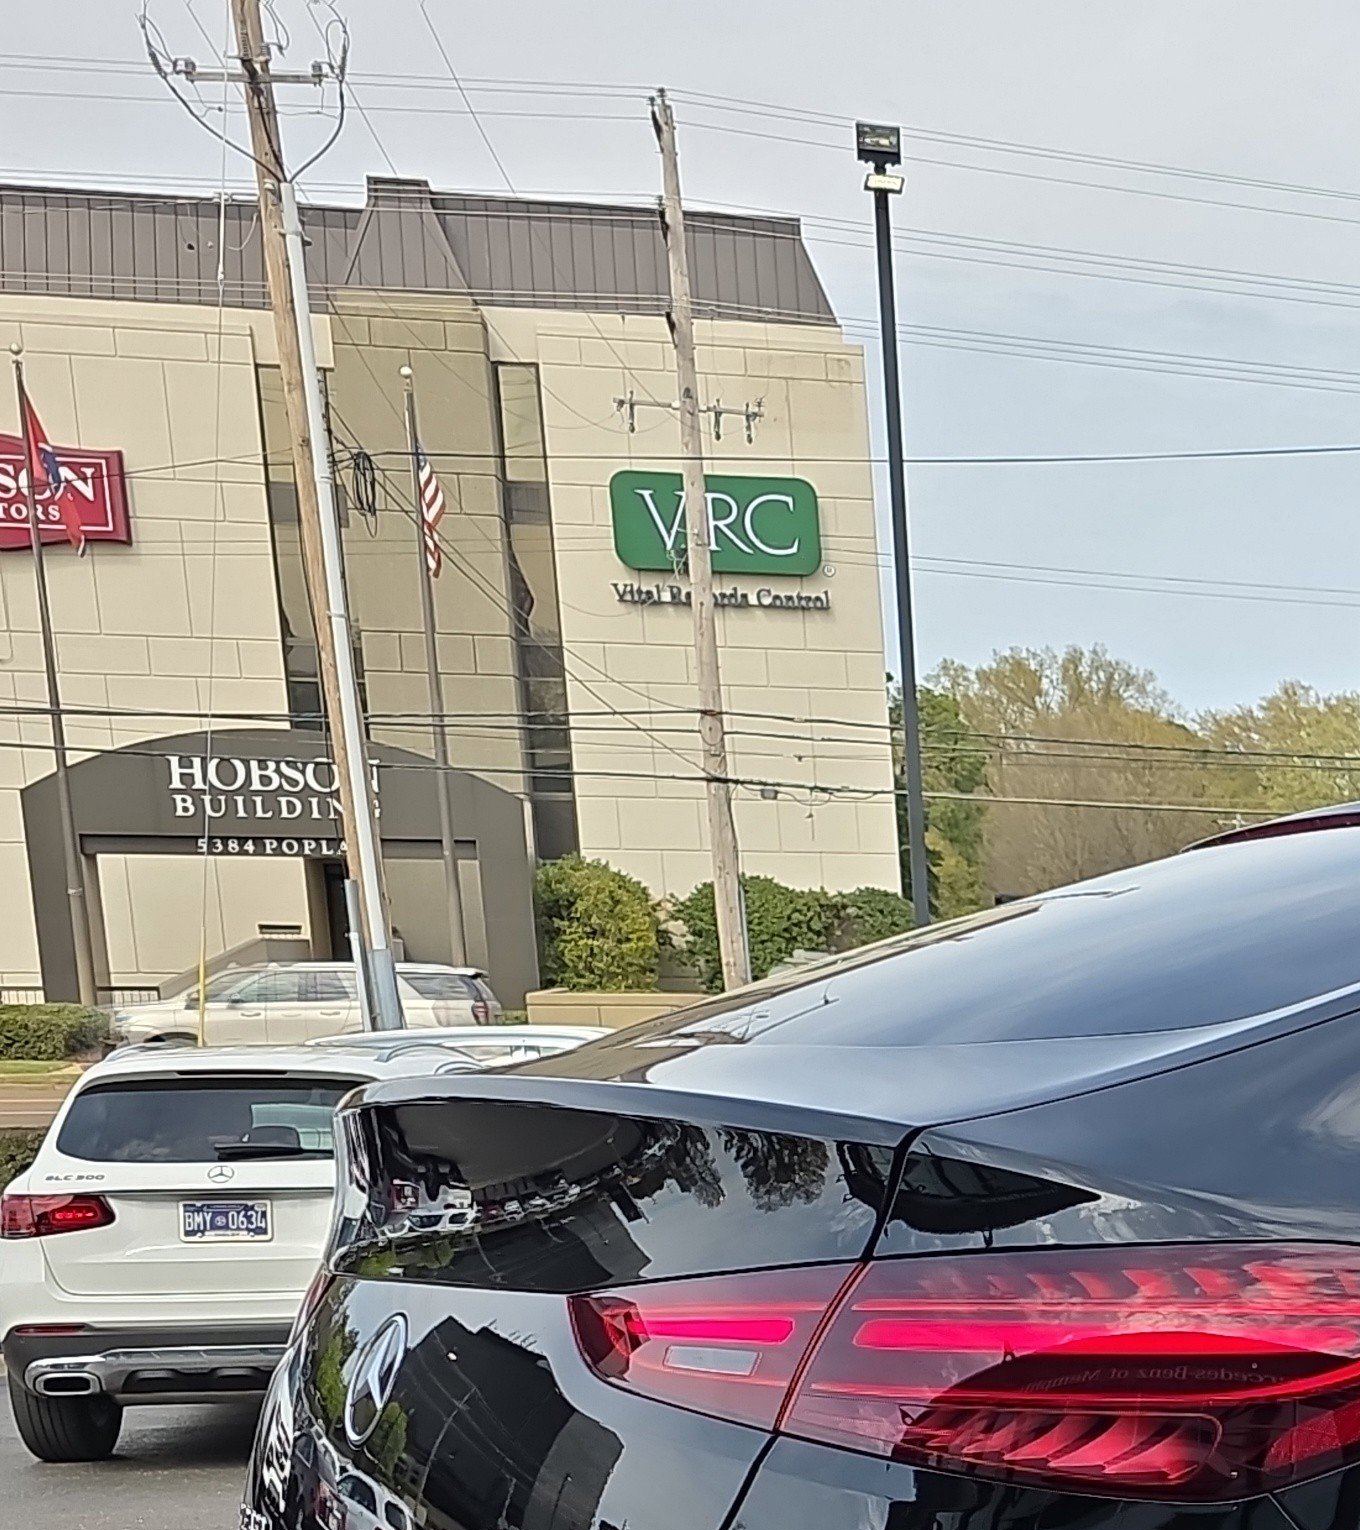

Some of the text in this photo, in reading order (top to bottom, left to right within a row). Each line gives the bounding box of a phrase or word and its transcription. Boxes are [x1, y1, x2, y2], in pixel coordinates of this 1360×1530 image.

[634, 489, 799, 556] VRC
[611, 582, 831, 611] Vital Rerds Control
[197, 838, 350, 855] 5384 POPLA
[184, 1210, 266, 1231] BMY 0634
